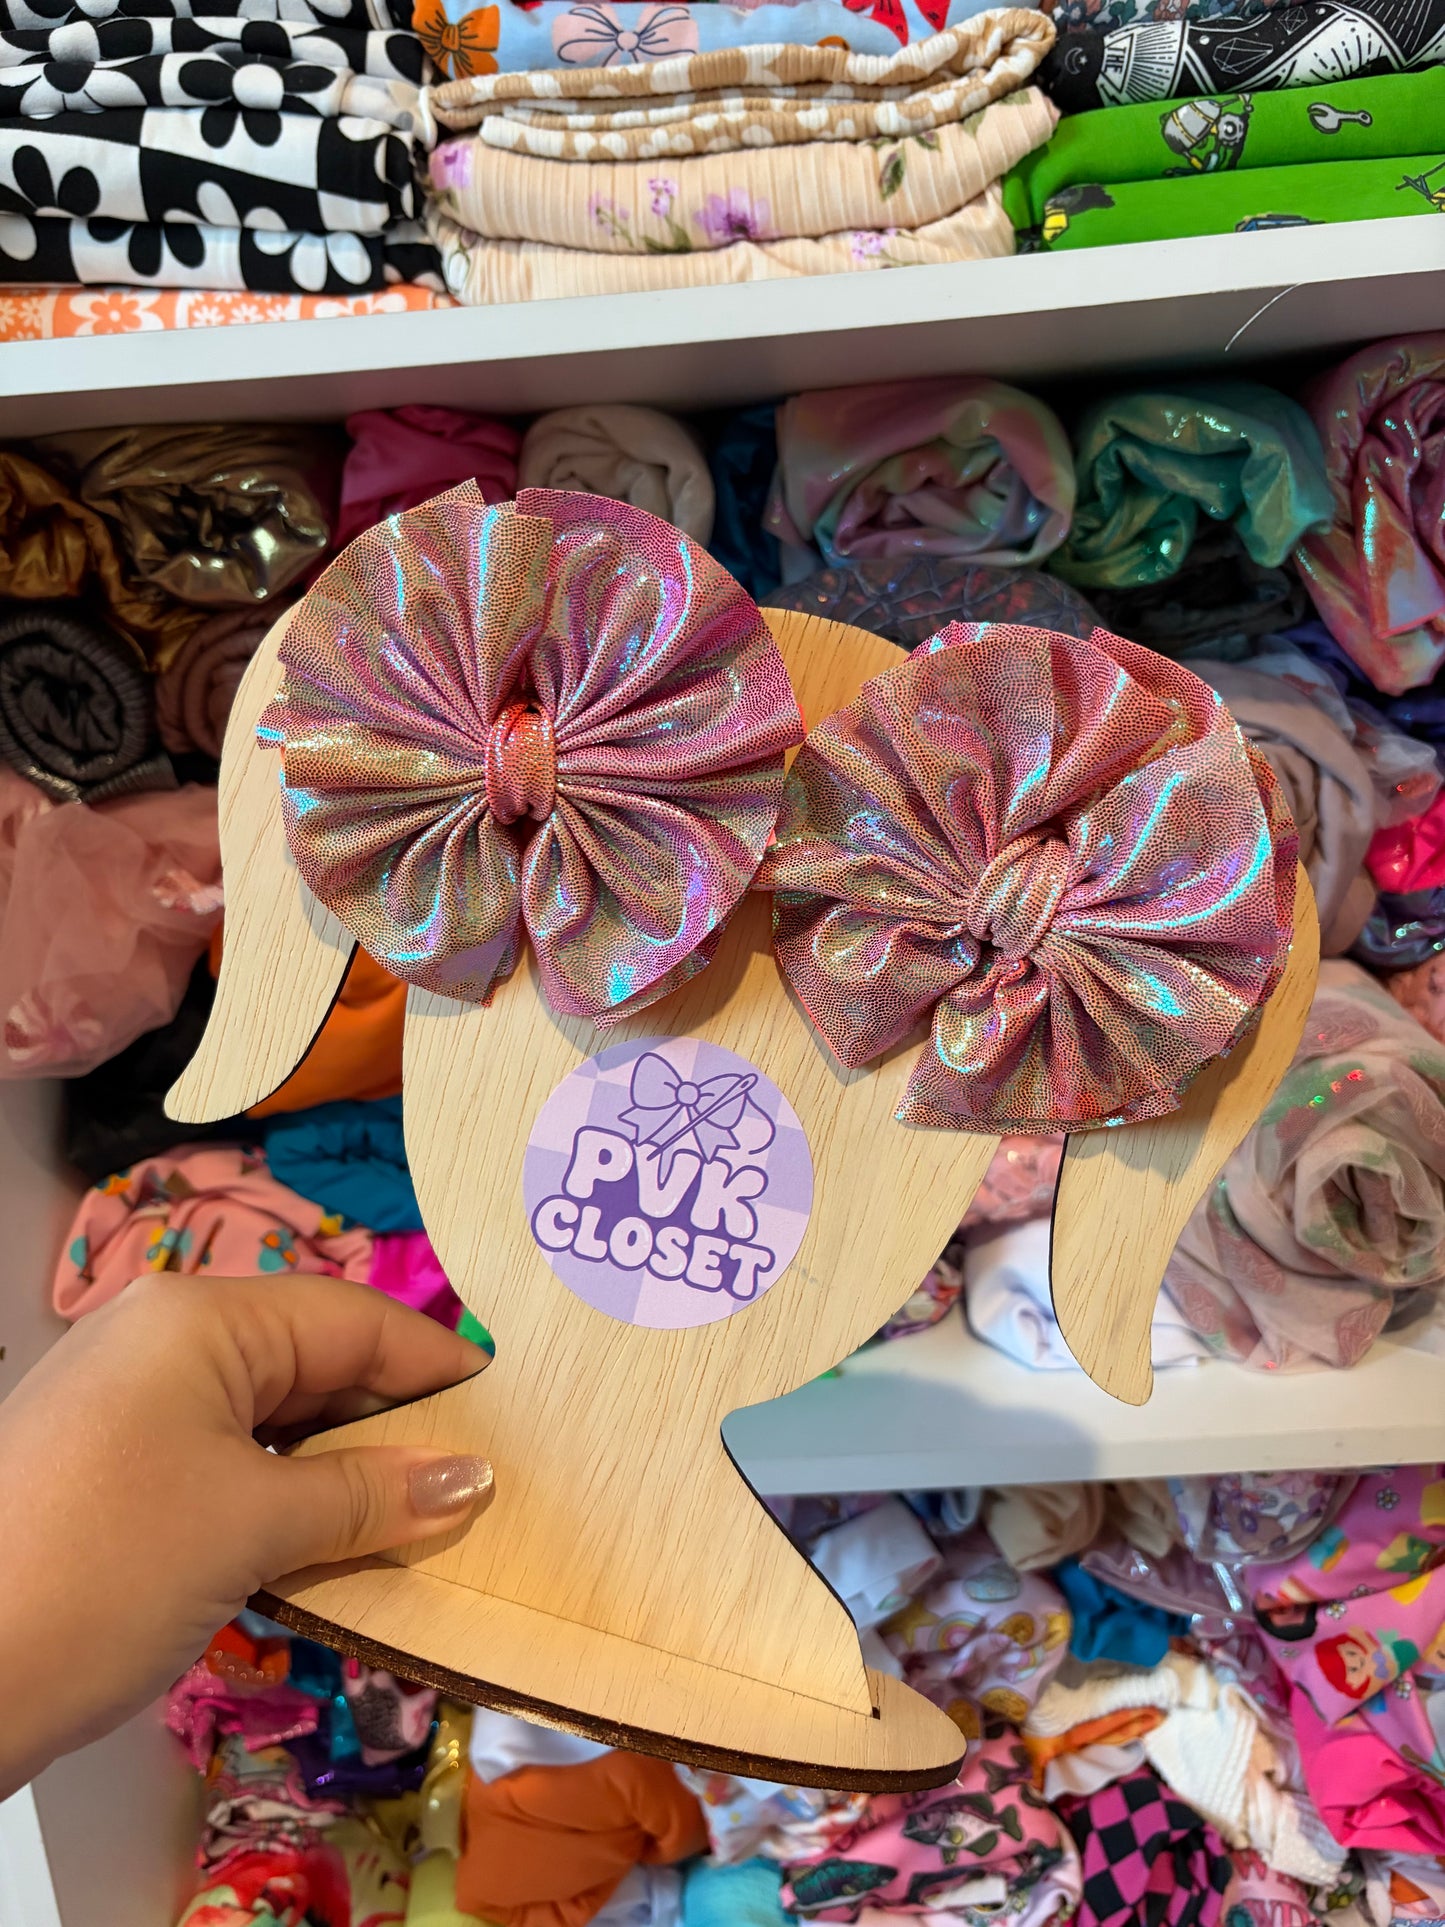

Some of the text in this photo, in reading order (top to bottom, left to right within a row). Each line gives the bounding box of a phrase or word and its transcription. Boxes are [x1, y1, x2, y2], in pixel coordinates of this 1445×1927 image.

[1104, 46, 1127, 74] THE
[562, 1125, 768, 1240] PVK
[531, 1194, 776, 1301] CLOSET
